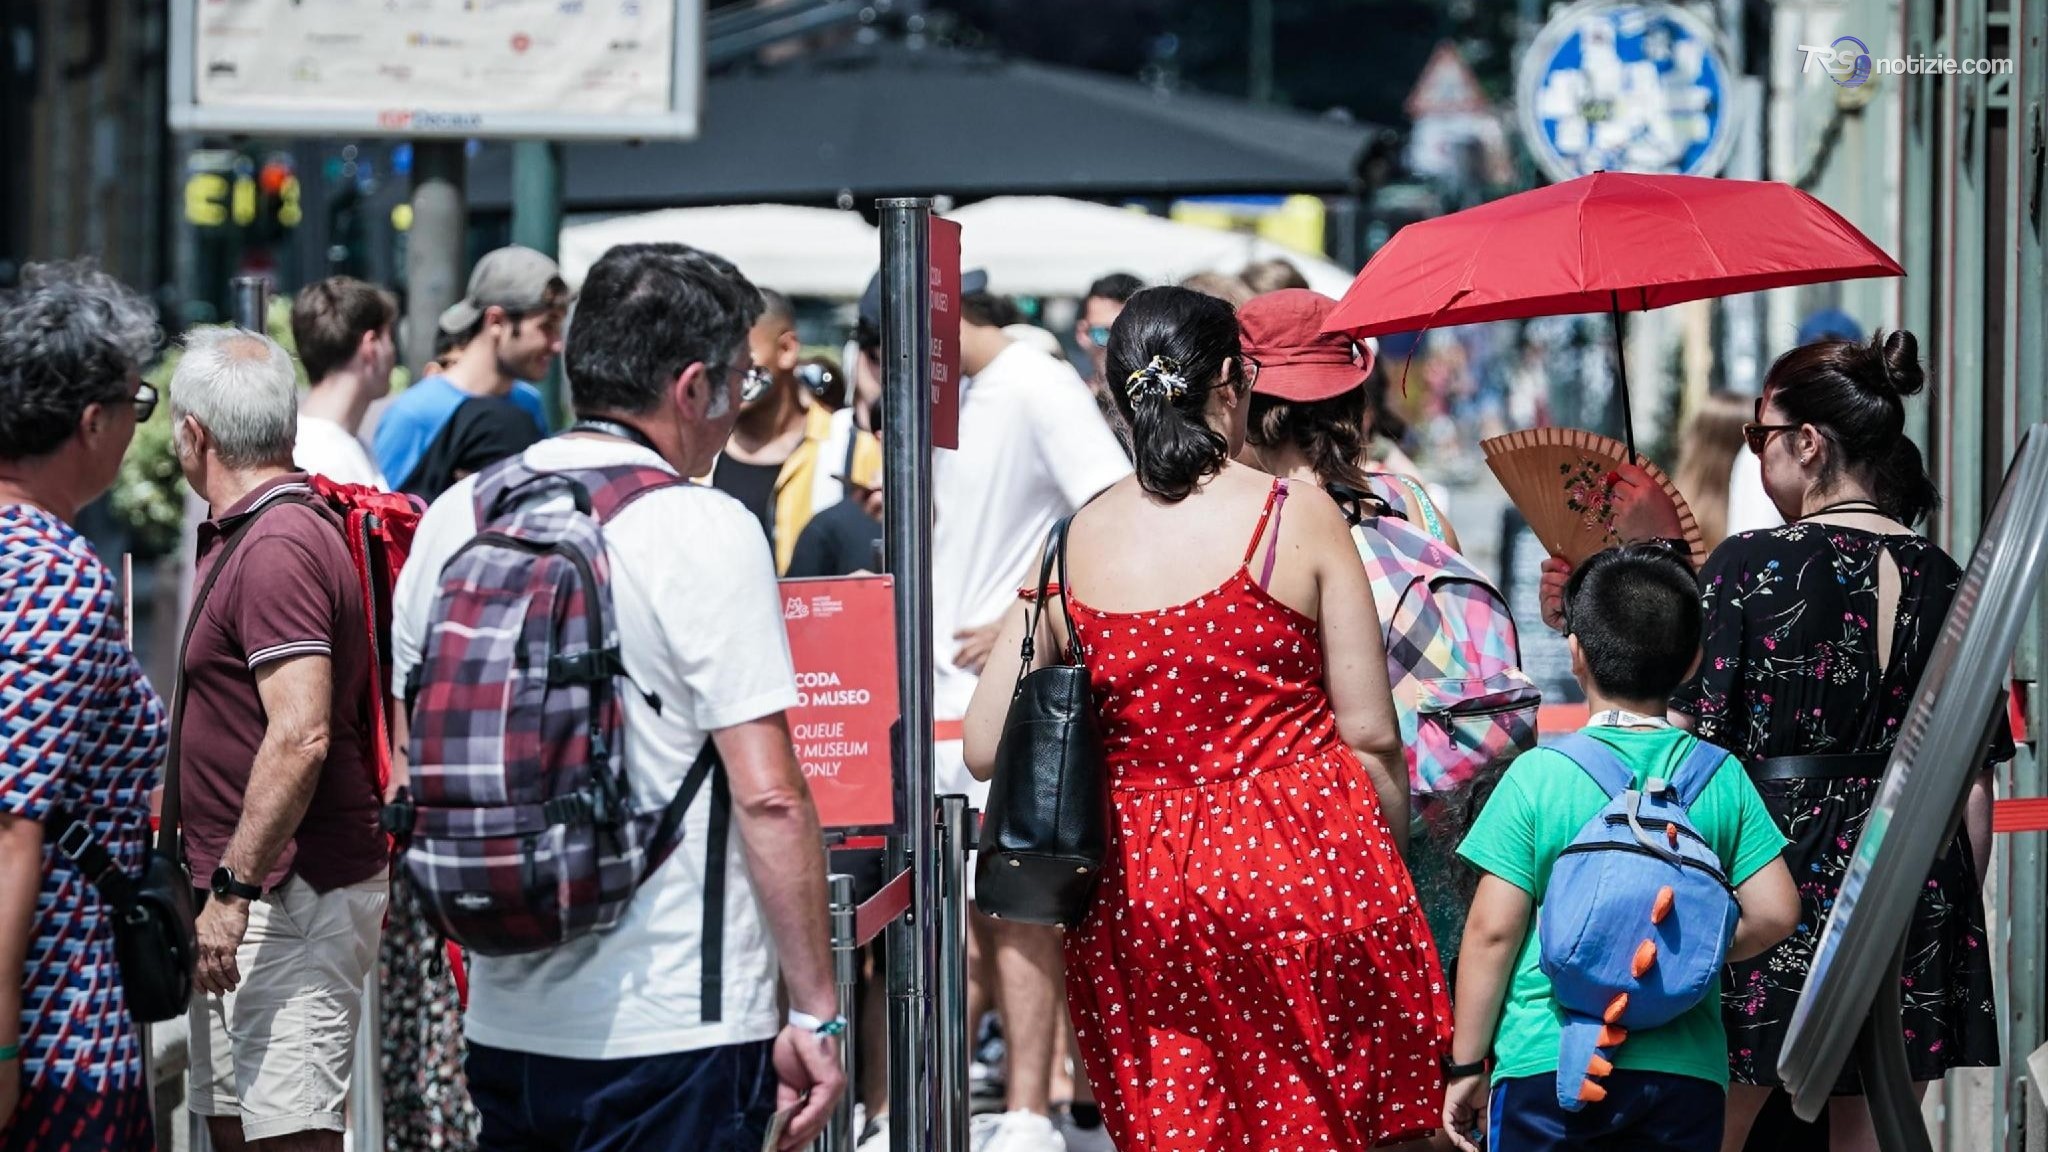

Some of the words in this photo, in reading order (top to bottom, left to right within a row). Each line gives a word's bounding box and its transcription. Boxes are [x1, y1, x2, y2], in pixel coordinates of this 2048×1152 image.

[795, 672, 841, 687] CODA
[812, 689, 870, 706] MUSEO
[794, 722, 844, 739] QUEUE
[803, 742, 868, 758] MUSEUM
[800, 761, 842, 778] ONLY
